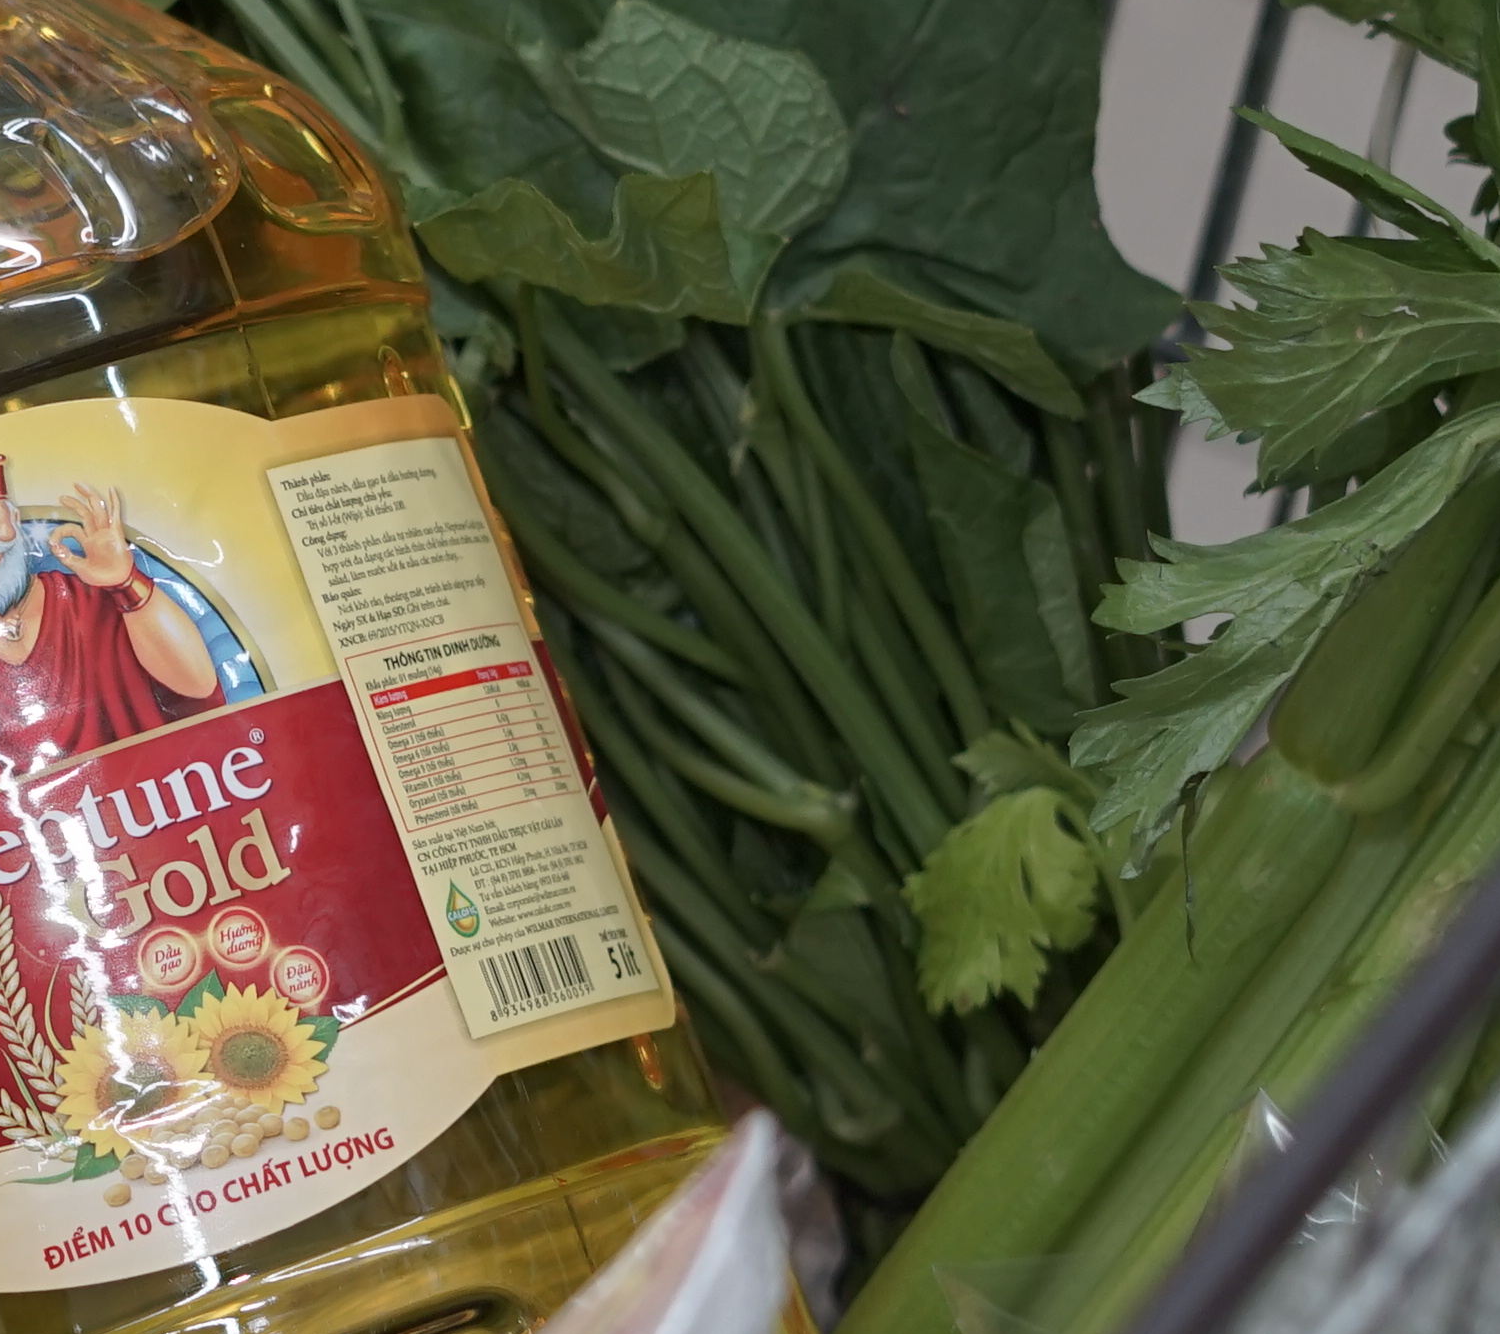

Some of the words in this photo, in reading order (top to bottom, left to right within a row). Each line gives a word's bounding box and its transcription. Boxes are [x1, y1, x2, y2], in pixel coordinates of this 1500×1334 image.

[383, 650, 425, 671] THÔNG
[423, 646, 442, 660] TIN
[442, 640, 470, 657] DINH
[68, 808, 291, 941] Gold
[154, 944, 182, 964] Dầu
[160, 958, 182, 978] gạo
[607, 947, 622, 979] 5
[618, 942, 641, 976] lít
[552, 981, 590, 1004] 360059
[43, 1227, 116, 1270] ĐIỂM
[119, 1213, 153, 1240] 10
[222, 1158, 293, 1203] CHẤT
[296, 1127, 395, 1178] LƯỢNG
